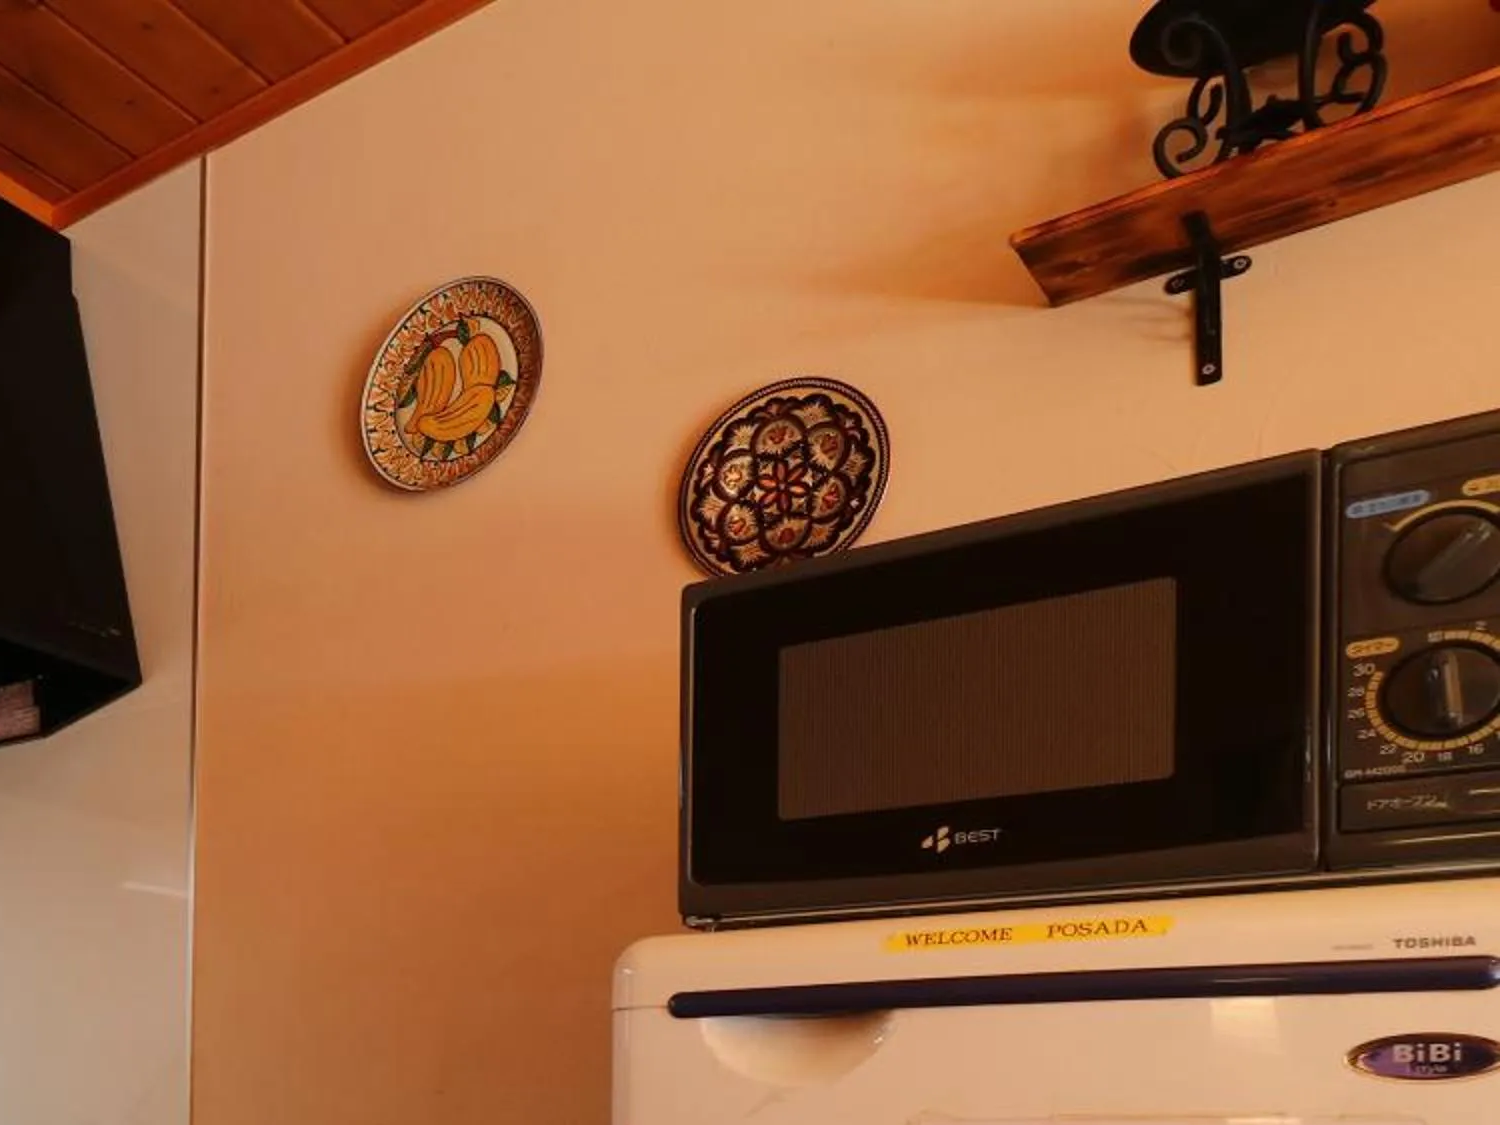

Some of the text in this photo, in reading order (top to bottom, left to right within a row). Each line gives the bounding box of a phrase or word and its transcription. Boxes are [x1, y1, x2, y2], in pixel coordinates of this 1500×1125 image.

[1353, 663, 1376, 677] 30
[1357, 729, 1376, 739] 24
[1402, 752, 1425, 764] 20
[954, 828, 1002, 845] BEST
[905, 918, 1149, 946] WELCOME POSADA
[1392, 935, 1477, 950] TOSHIBA
[1392, 1042, 1462, 1064] BiBi
